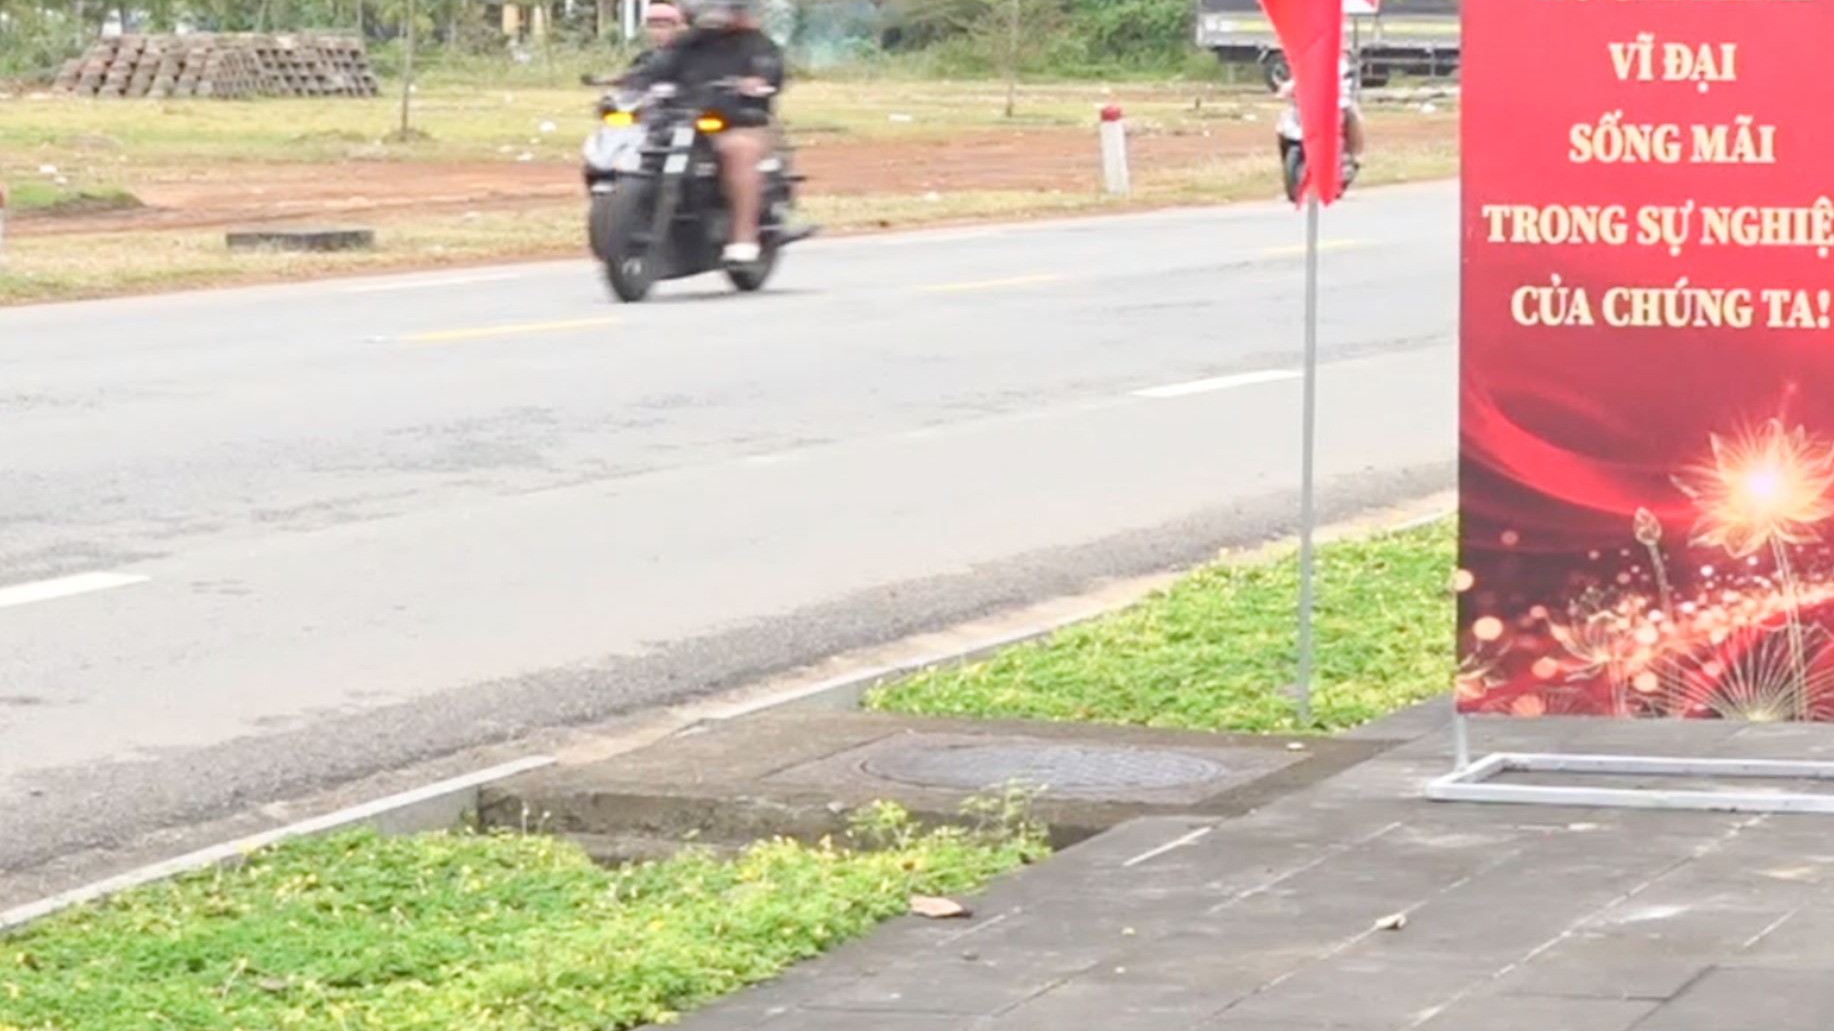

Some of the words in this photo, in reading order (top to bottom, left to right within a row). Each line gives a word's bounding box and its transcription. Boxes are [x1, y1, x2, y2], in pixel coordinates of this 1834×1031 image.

[1608, 32, 1654, 82] VĨ
[1662, 43, 1737, 94] ĐẠI
[1568, 109, 1682, 164] SỐNG
[1690, 116, 1776, 164] MÃI
[1482, 204, 1627, 244] TRONG
[1636, 200, 1694, 257] SỰ
[1510, 273, 1594, 326] CỦA
[1602, 277, 1753, 328] CHÚNG
[1761, 290, 1832, 330] TA!
